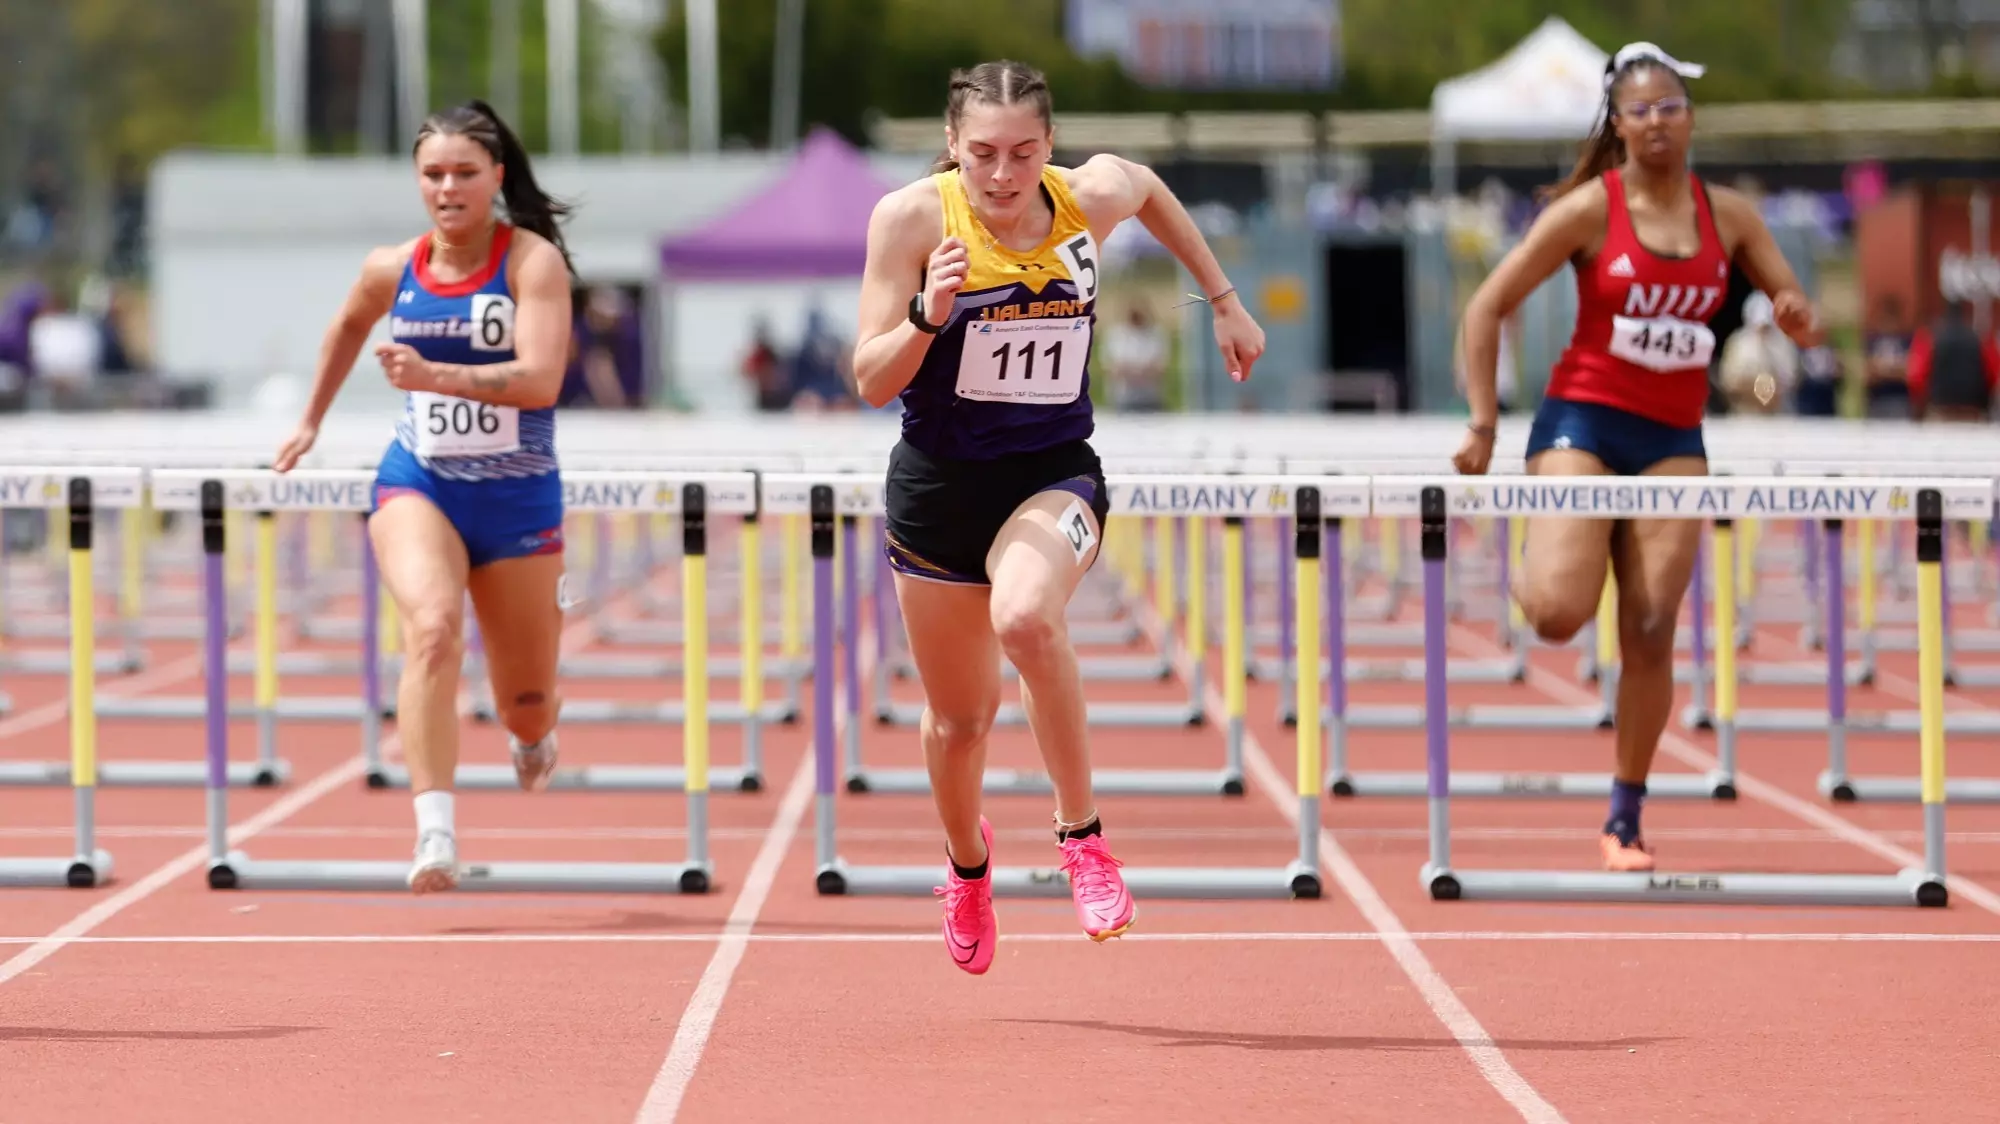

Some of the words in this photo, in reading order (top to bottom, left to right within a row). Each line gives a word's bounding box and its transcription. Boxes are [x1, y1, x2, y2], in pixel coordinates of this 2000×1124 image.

[1068, 236, 1097, 297] 5
[482, 301, 504, 346] 6
[983, 300, 1087, 322] UALBANY
[1631, 324, 1696, 360] 443
[992, 341, 1062, 380] 111
[428, 402, 499, 434] 506
[270, 480, 364, 504] UNIVE
[563, 481, 644, 505] BANY
[1129, 484, 1258, 510] ALBANY
[1493, 485, 1686, 511] UNIVERSITY
[1697, 487, 1734, 511] AT
[1745, 487, 1877, 512] ALBANY
[1067, 513, 1089, 552] 5
